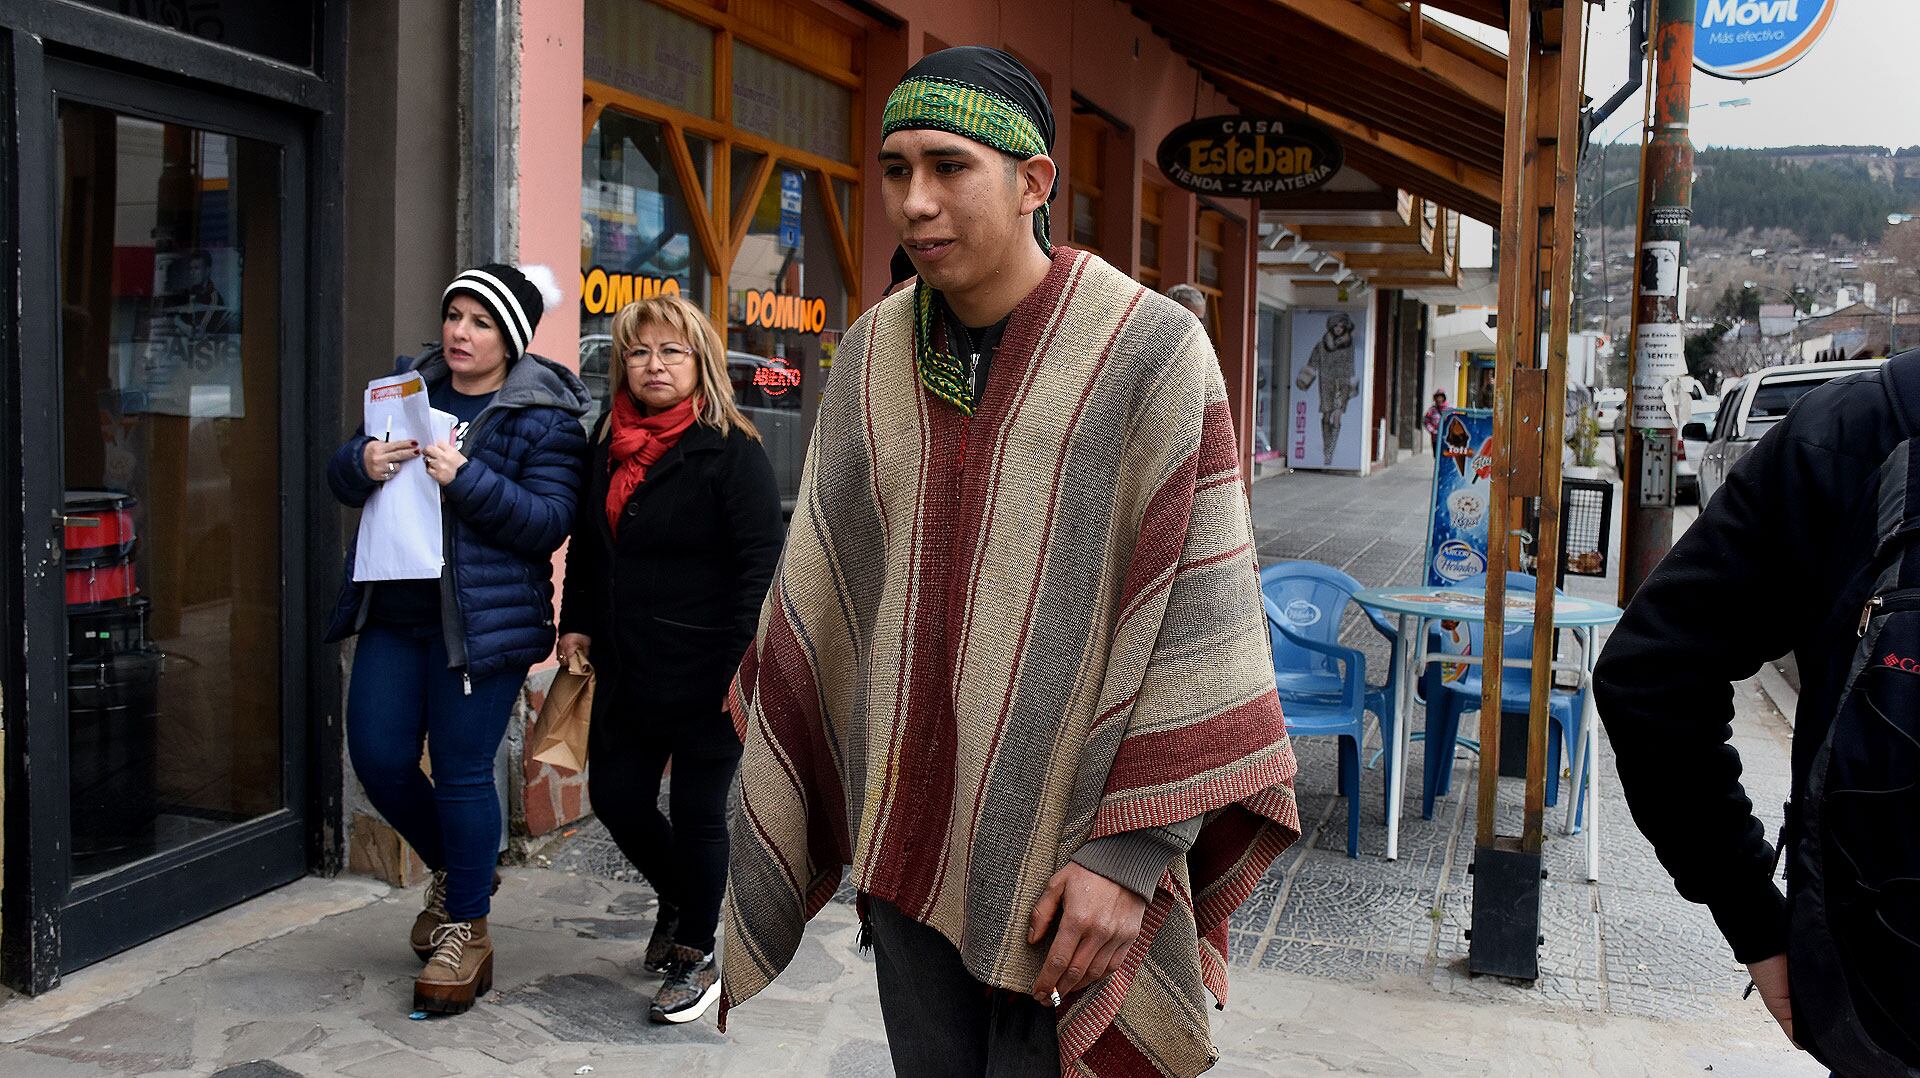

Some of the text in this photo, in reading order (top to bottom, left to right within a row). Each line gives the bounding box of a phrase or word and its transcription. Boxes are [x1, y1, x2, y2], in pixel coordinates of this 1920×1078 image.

[1709, 31, 1735, 45] Más
[1222, 121, 1284, 134] CASA
[1188, 135, 1313, 175] Esteban
[1168, 162, 1223, 192] TIENDA
[1241, 163, 1332, 193] ZAPATERIA
[745, 289, 827, 335] DOMINO
[1295, 401, 1307, 459] BLISS
